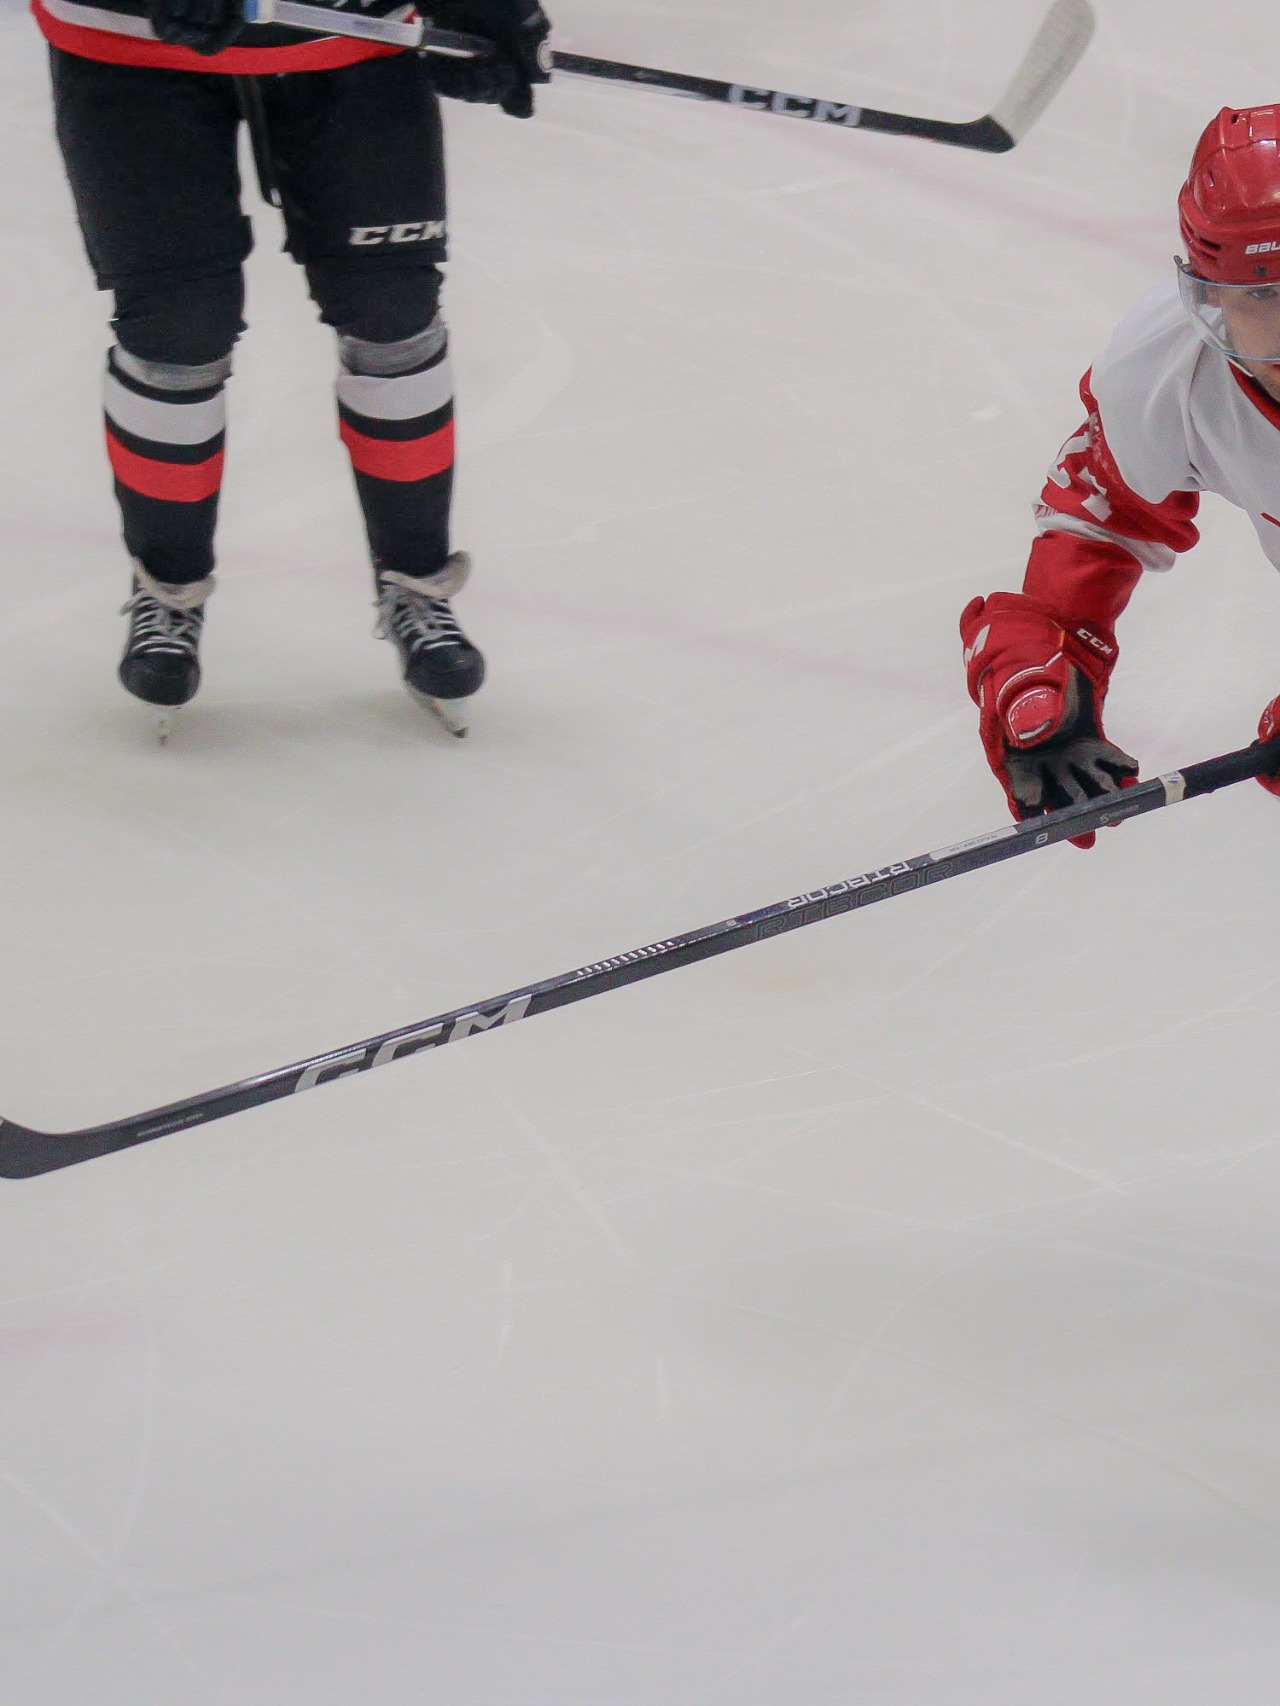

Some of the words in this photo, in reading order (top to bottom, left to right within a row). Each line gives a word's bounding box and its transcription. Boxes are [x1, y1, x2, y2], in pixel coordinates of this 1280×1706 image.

[728, 83, 862, 128] CCM
[349, 220, 446, 245] CCM
[1076, 628, 1113, 655] CCM
[294, 993, 534, 1093] CCM
